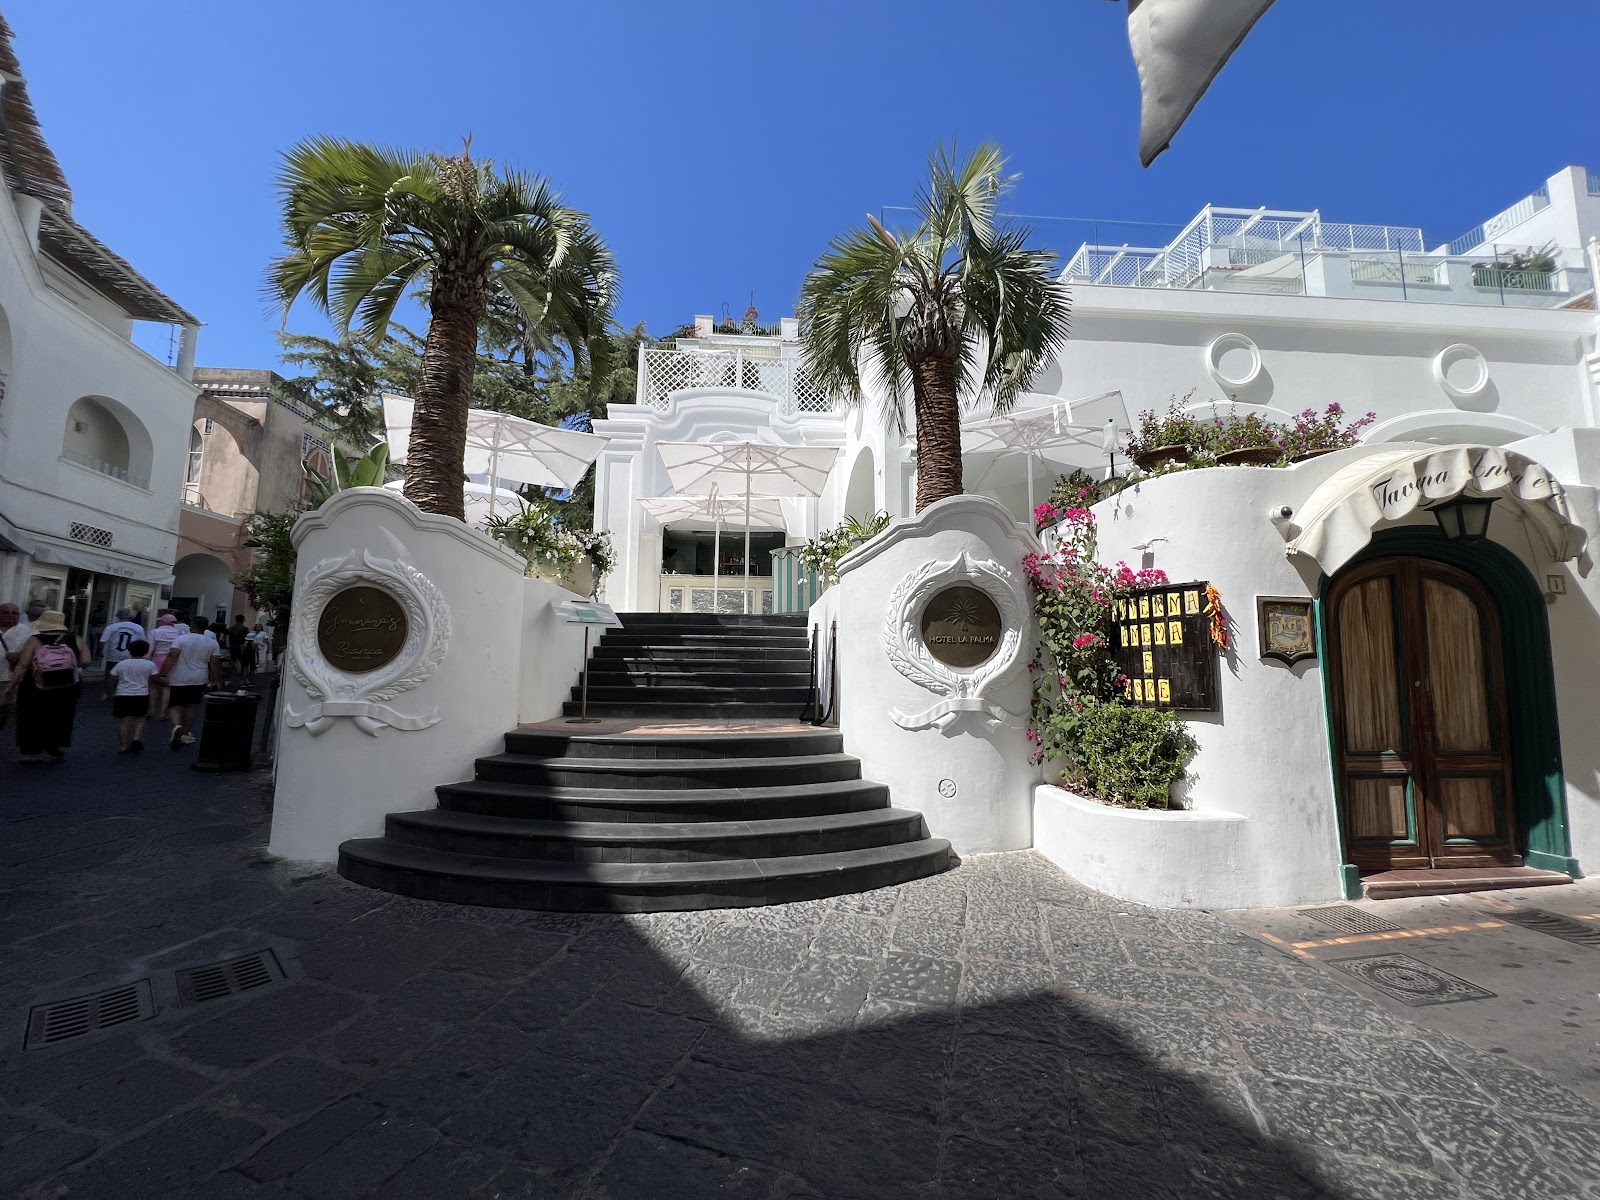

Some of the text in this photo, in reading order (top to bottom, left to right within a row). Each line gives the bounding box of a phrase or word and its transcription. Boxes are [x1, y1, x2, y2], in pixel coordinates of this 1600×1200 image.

[1112, 593, 1198, 621] AVERNA
[929, 635, 995, 644] HOTEL LA PALMA
[335, 641, 384, 657] Bianca
[1144, 653, 1152, 671] E
[1126, 680, 1169, 699] ORE
